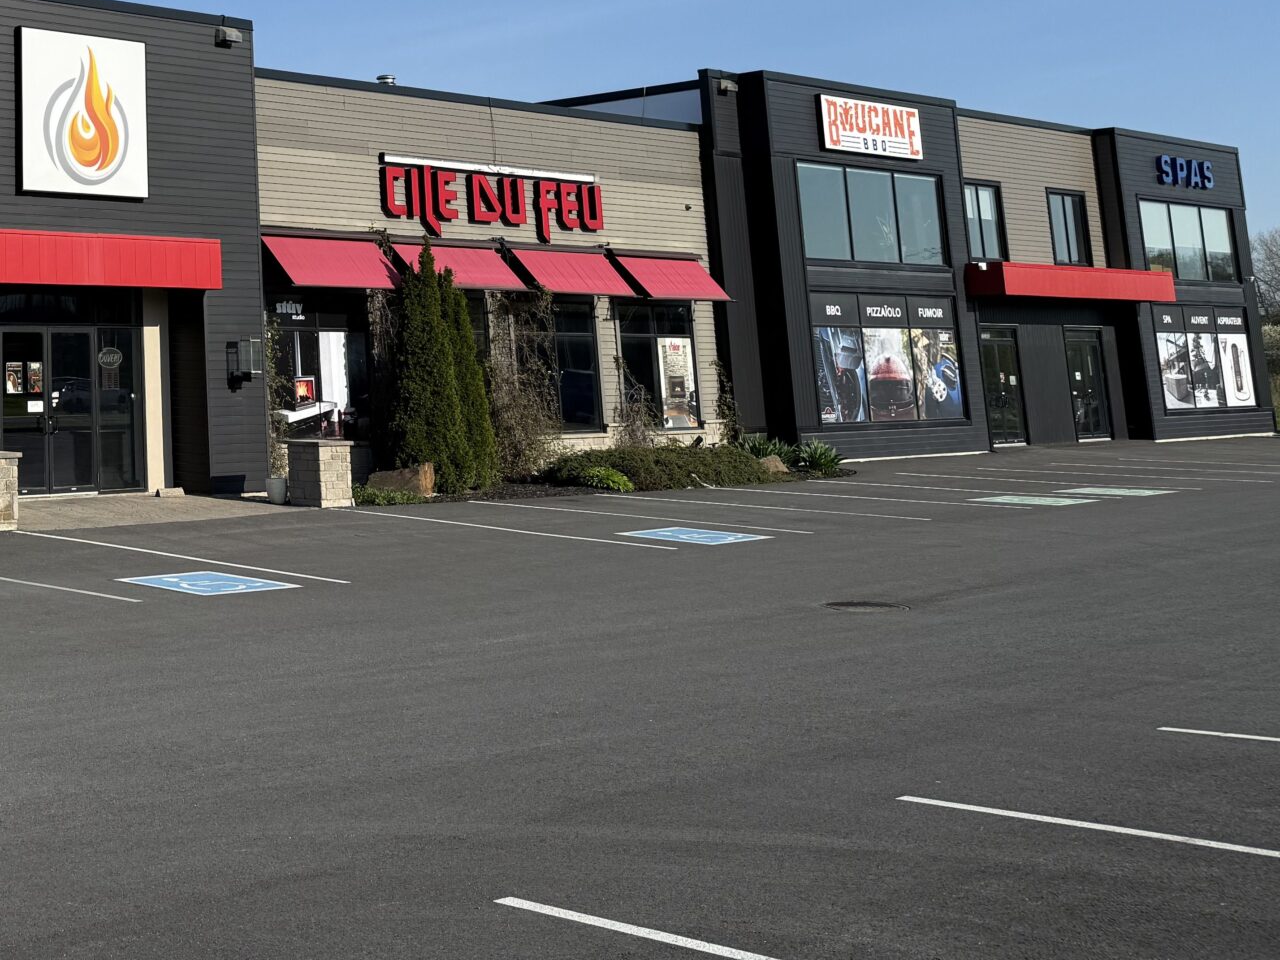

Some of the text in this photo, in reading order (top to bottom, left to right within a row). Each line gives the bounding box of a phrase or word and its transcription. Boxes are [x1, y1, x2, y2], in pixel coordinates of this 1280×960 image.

[863, 138, 887, 152] BBQ
[1160, 154, 1215, 189] SPAS
[470, 174, 527, 224] DU
[536, 180, 604, 245] FEU
[825, 305, 842, 316] BBQ
[918, 308, 944, 318] FUMOIR
[1162, 315, 1172, 324] SPA
